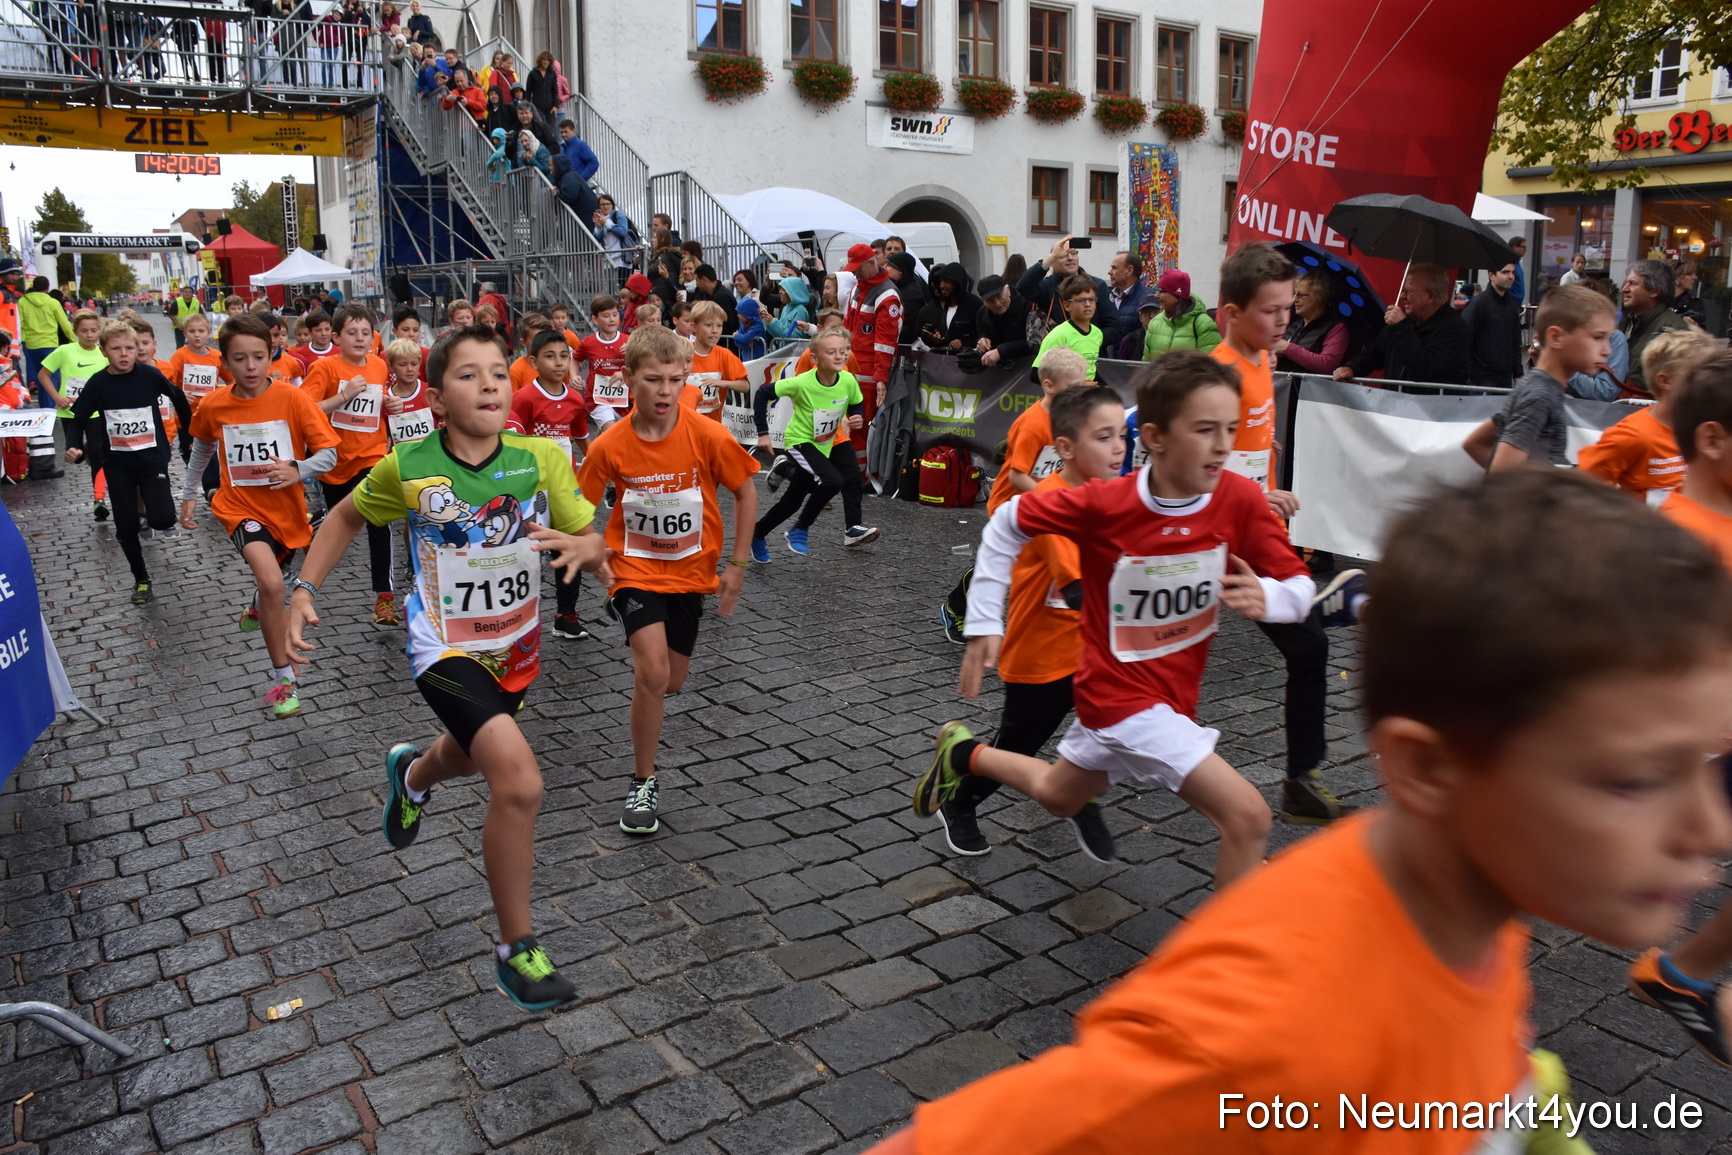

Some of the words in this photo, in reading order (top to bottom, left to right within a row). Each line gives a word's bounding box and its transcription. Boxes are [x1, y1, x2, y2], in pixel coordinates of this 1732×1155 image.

[125, 117, 209, 147] ZIEL
[890, 116, 933, 134] swn
[252, 135, 295, 143] Neumarkter
[296, 135, 327, 143] Stadtlauf
[890, 132, 918, 141] stadtwerke
[918, 134, 944, 143] neumarkt
[1248, 119, 1340, 169] STORE
[1613, 126, 1667, 151] Der
[70, 236, 100, 247] MINI
[102, 236, 173, 248] NEUMARKT.
[188, 373, 212, 385] 7188
[71, 386, 84, 396] 70
[599, 384, 624, 397] 7079
[0, 418, 33, 429] swn
[113, 420, 148, 436] 7323
[351, 416, 365, 424] David
[820, 416, 841, 434] 711
[396, 421, 429, 439] 7045
[233, 440, 280, 463] 7151
[250, 465, 271, 476] Jako
[634, 511, 692, 535] 7166
[650, 541, 679, 550] Marcel
[479, 553, 518, 567] BOCK
[454, 570, 530, 612] 7138
[1128, 580, 1213, 620] 7006
[474, 612, 523, 633] Benjamin
[1155, 625, 1190, 641] Lukas
